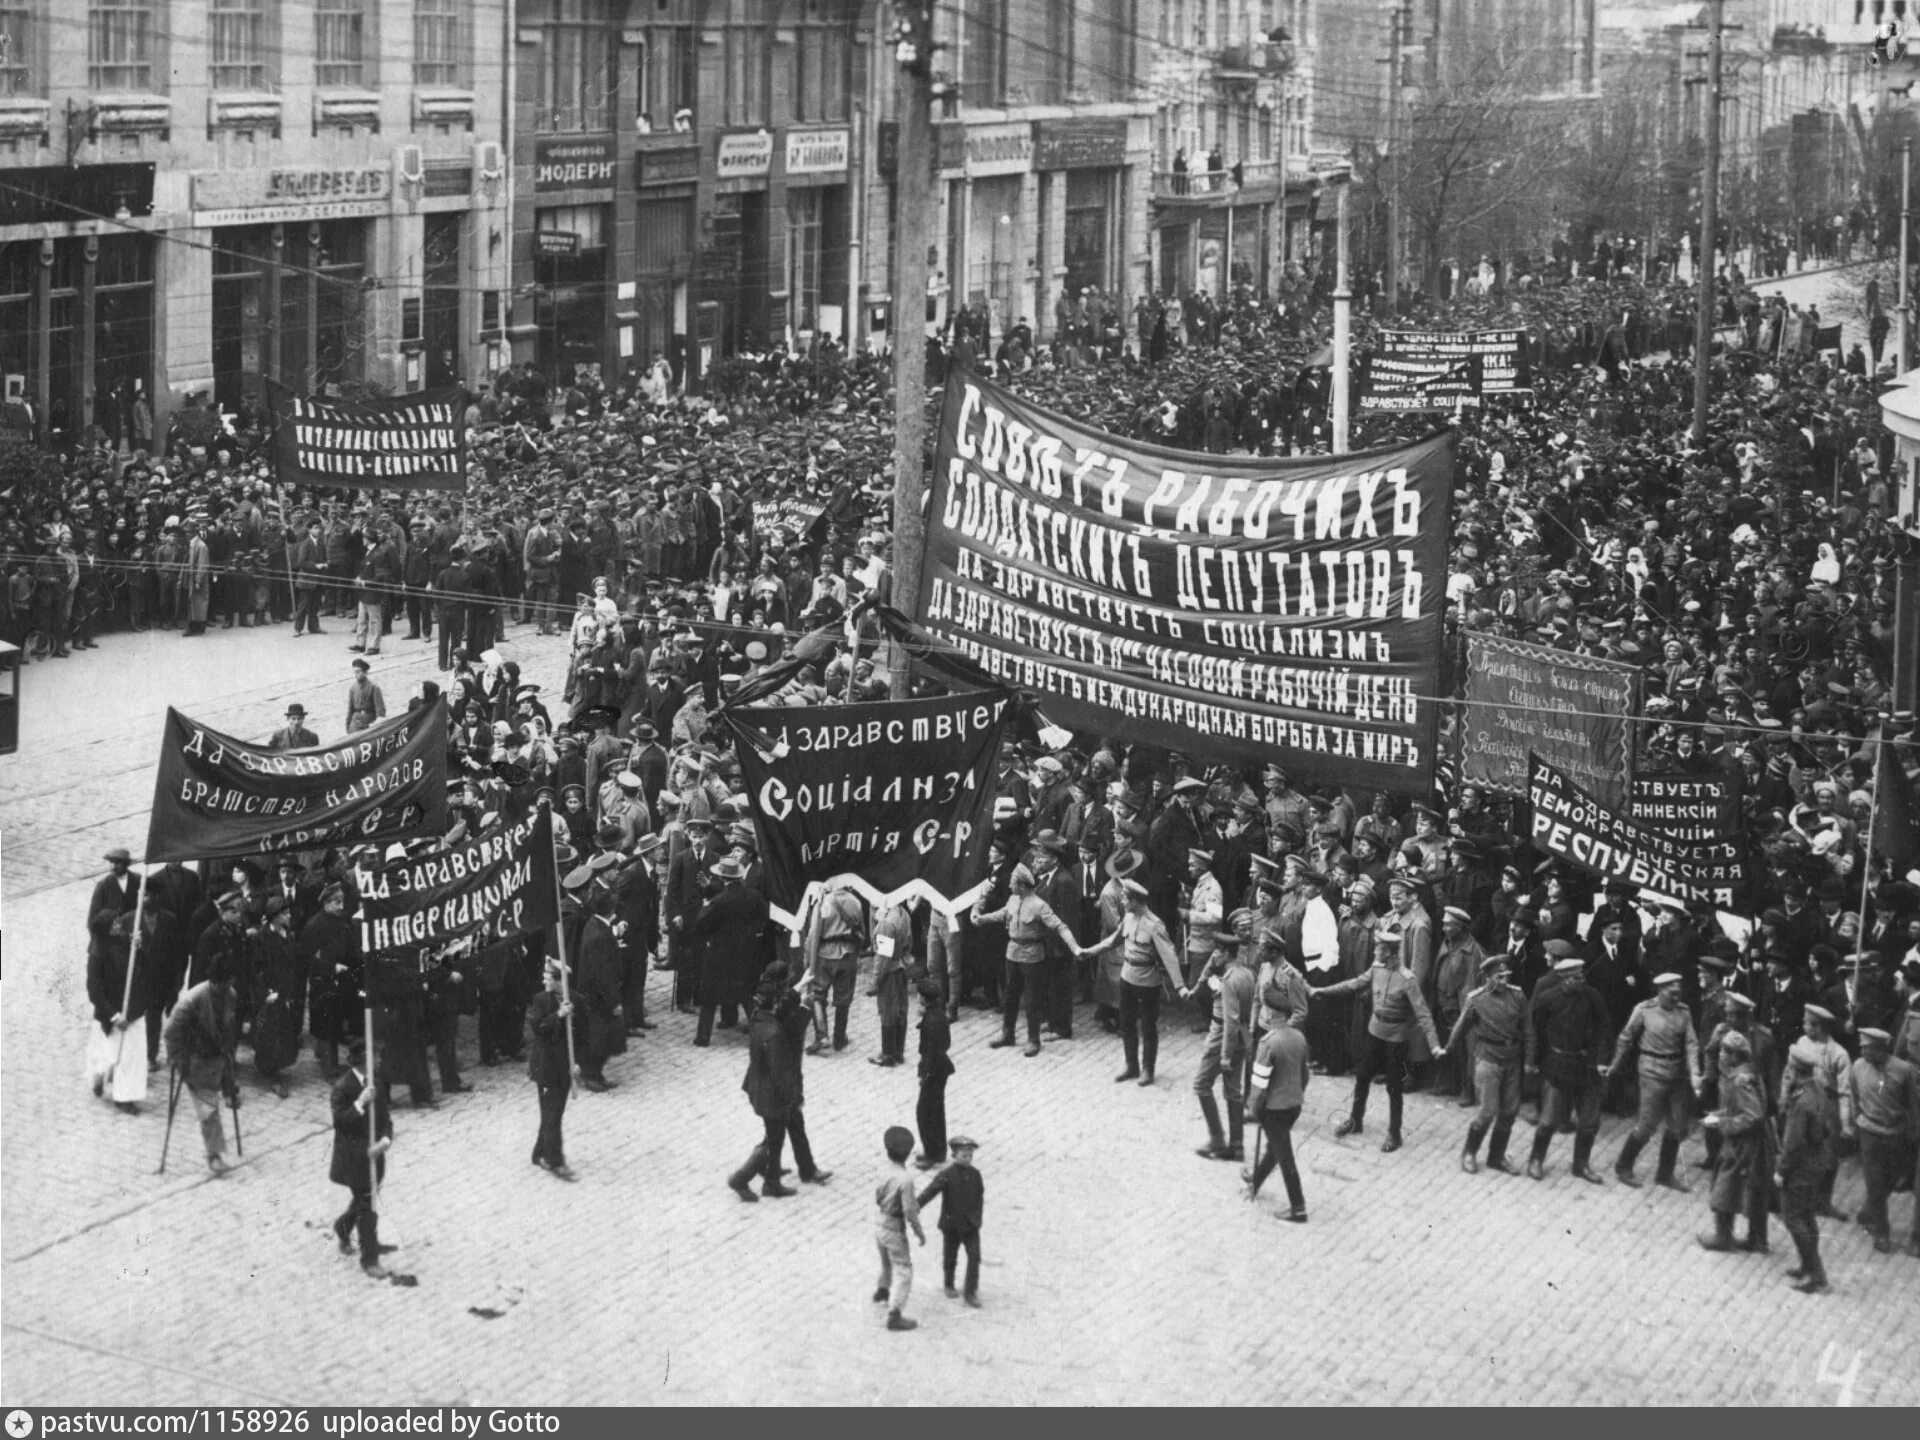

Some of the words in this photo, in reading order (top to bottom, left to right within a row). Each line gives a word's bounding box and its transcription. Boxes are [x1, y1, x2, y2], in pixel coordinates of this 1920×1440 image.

[957, 384, 1130, 518] СОВѢТЪ
[1144, 468, 1422, 541] РАБОЧИХЪ
[943, 457, 1153, 598] СОЛДАТСКИХЪ
[1177, 543, 1423, 619] ДЕПУТАТОВЪ
[957, 547, 984, 581] ДА
[992, 560, 1182, 639] ЗДРАВСТВУЕТЪ
[1203, 620, 1390, 663] СОЦІАЛИЗМЪ
[1087, 676, 1246, 739] МЕЖДУНАРОДНАЯ
[1252, 714, 1327, 753] БОРЬБА
[1333, 726, 1356, 758] ЗА
[1363, 731, 1419, 768] МИРЪ
[1146, 644, 1245, 698] ЧАСОВОЙ
[1250, 663, 1350, 714] РАБОЧІЙ
[1355, 675, 1417, 724] ДЕНЬ
[1534, 764, 1562, 789] ДА
[1573, 787, 1737, 861] ЗДРАВСТВУЕТЪ
[1633, 781, 1722, 798] ТВУЕТЪ
[1531, 812, 1733, 908] РЕСПУБЛИКА
